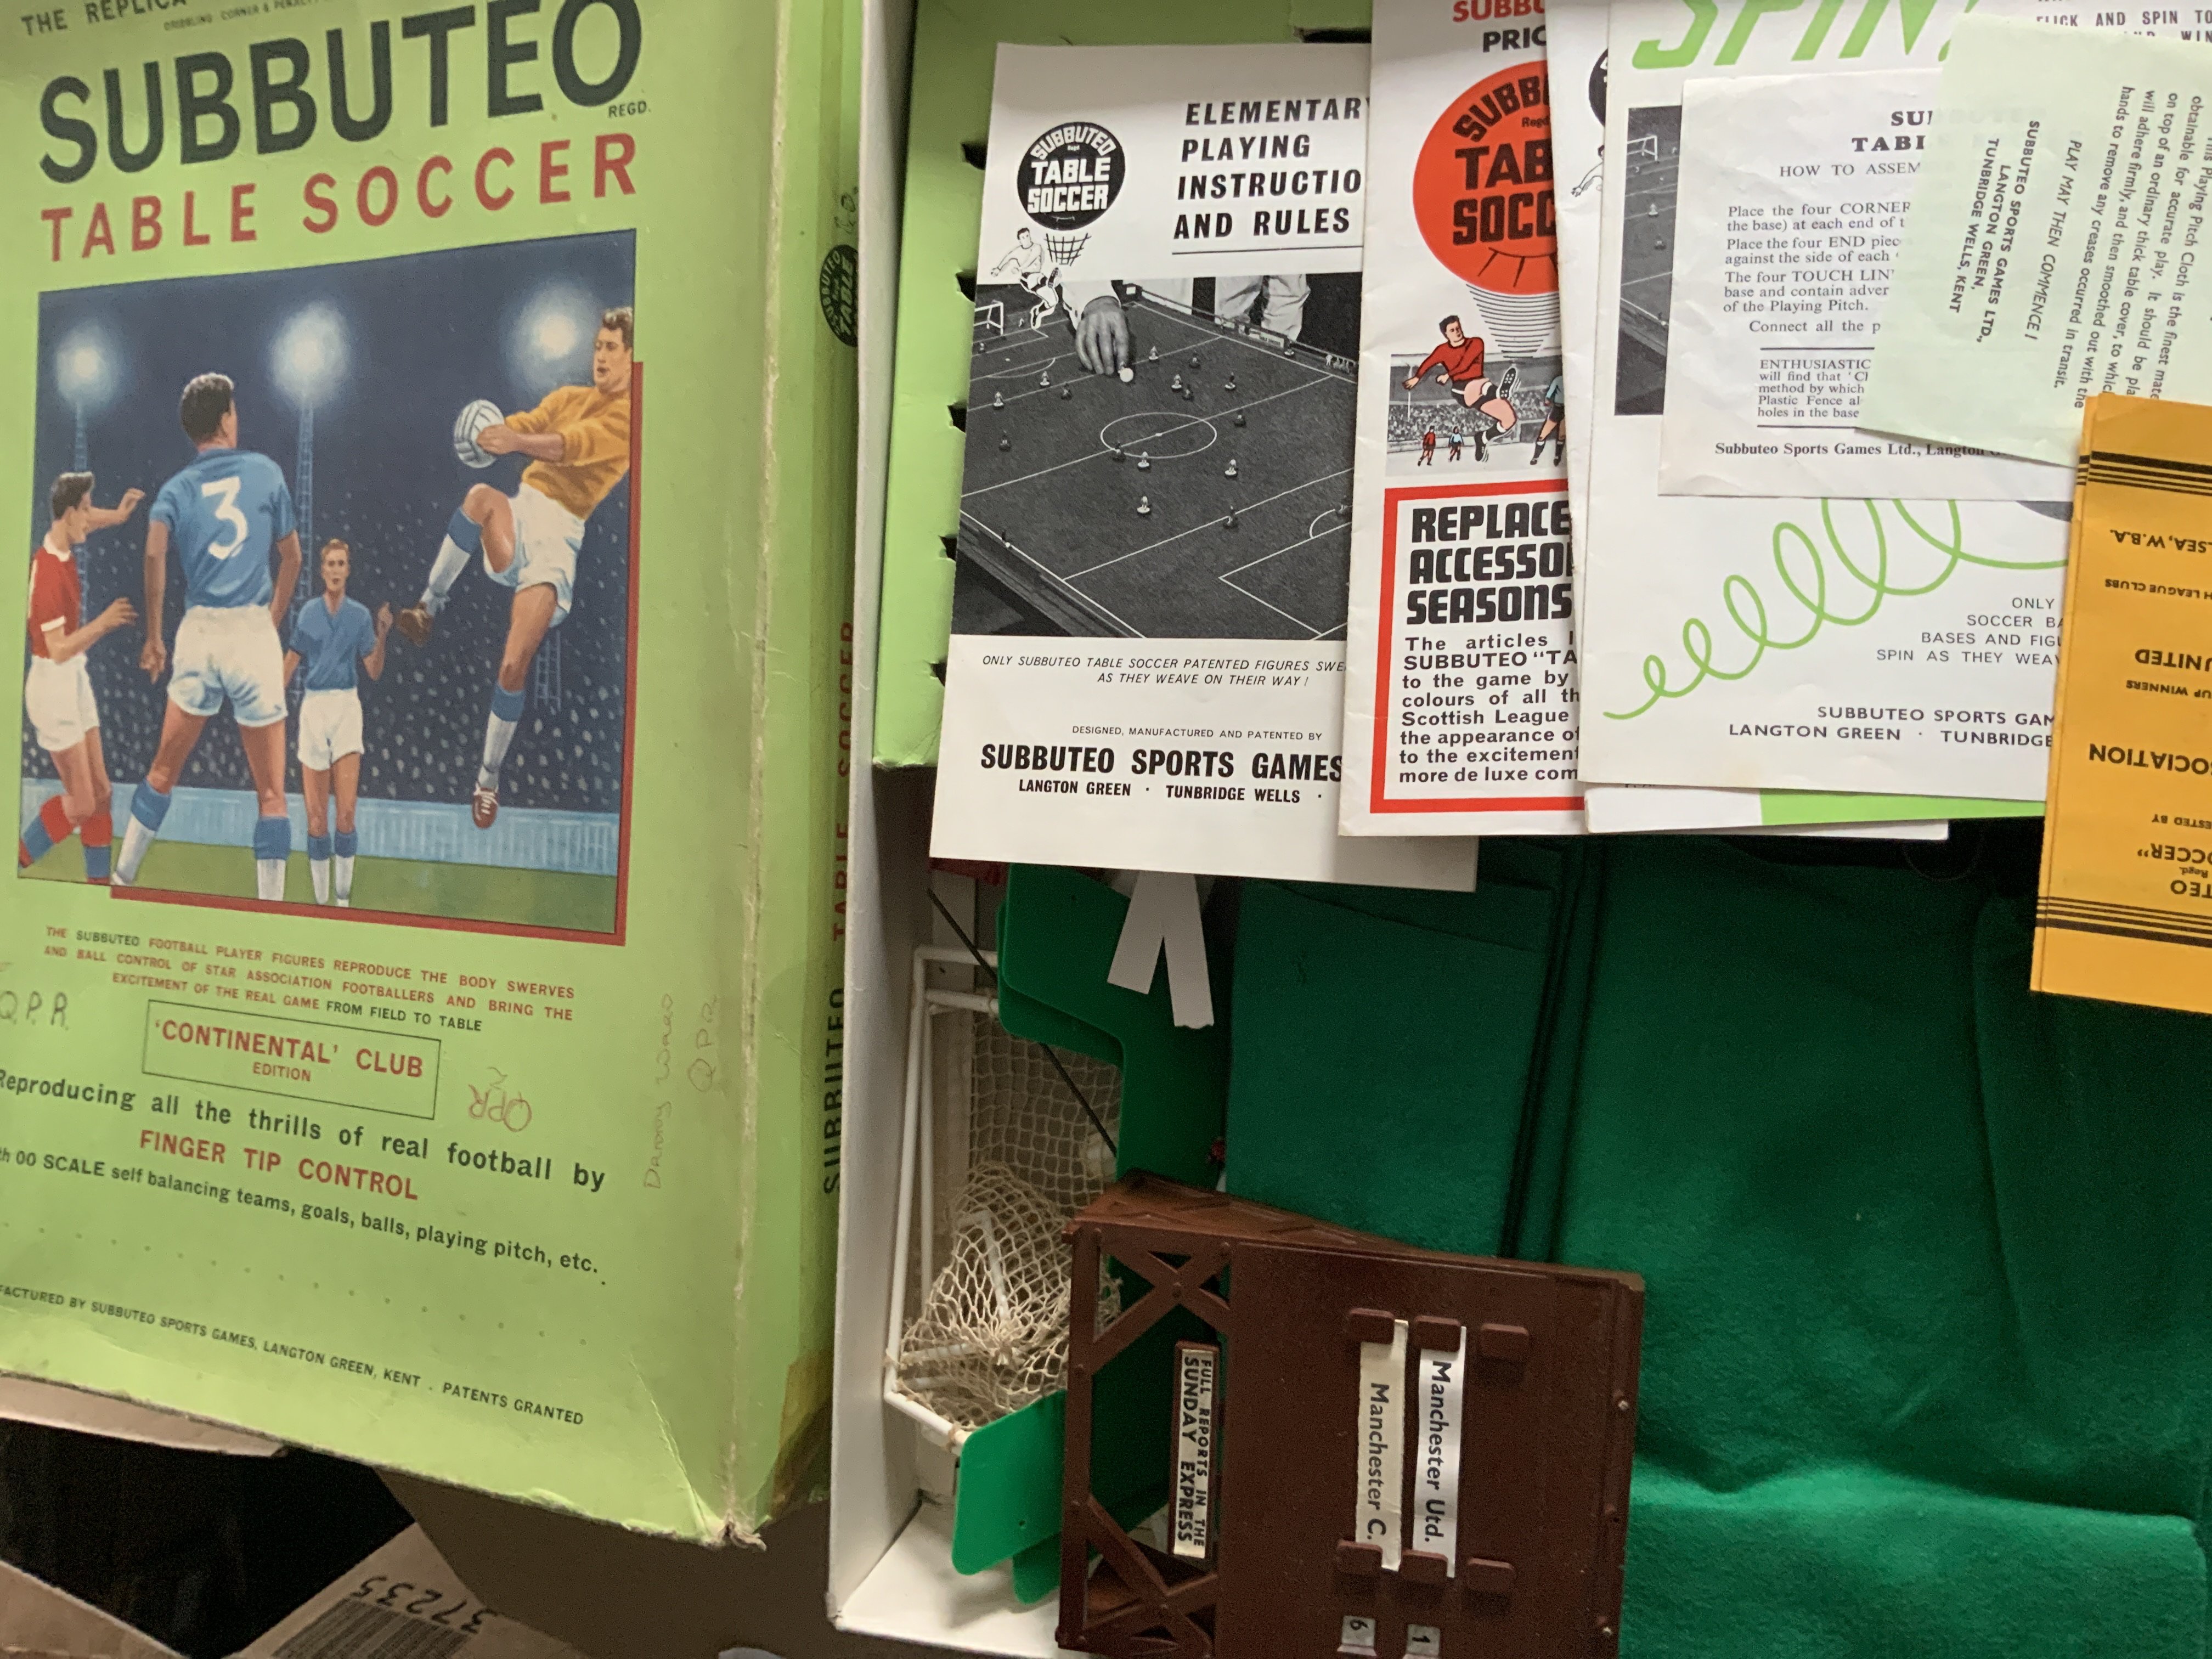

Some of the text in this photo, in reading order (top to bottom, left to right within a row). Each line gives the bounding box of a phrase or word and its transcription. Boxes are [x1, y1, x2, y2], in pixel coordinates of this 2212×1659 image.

[21, 8, 67, 36] THE
[2096, 11, 2177, 26] AND SPIN
[39, 0, 651, 184] SUBBUTEO REGD.
[1452, 75, 1550, 143] SUBB
[1182, 134, 1309, 162] PLAYING
[1031, 157, 1111, 185] TABLE
[1781, 165, 1854, 177] HOW TO
[41, 133, 636, 262] TABLE SOCCER
[1028, 184, 1109, 213] SOCCER
[1729, 204, 1831, 217] Place the four
[1174, 208, 1349, 239] AND RULES
[1950, 139, 1999, 313] TUNBRIDGE WELLS, KENT
[1988, 121, 2040, 304] SUBBUTEO SPORTS GAMES
[1971, 165, 2011, 290] LANGTON GREEN,
[2027, 140, 2082, 331] PLAY MAY THEN COMMENCE
[1770, 300, 1867, 314] Playing Pitch.
[1716, 443, 1921, 457] Subbuteo Sports Games Ltd.,
[201, 476, 248, 560] 3
[2111, 530, 2165, 548] W.B.A.
[1409, 541, 1573, 585] ACCESSO
[2105, 579, 2200, 598] LEAGUE CLUBS
[1407, 583, 1572, 625] SEASONS
[2012, 597, 2054, 609] ONLY
[1967, 615, 2032, 627] SOCCER
[1405, 633, 1547, 651] The articles
[1922, 633, 2021, 645] BASES AND
[983, 656, 1309, 671] ONLY SUBBUTEO TABLE SOCCER PATENTED FIGURES
[1404, 652, 1527, 670] SUBBUTEO
[1098, 673, 1300, 685] AS THEY WEAVE ON THEIR WAY
[1402, 670, 1569, 690] to the game by
[2126, 680, 2188, 696] WINNERS
[1402, 689, 1545, 707] colours of all
[1402, 710, 1569, 726] Scottish League
[1818, 707, 2006, 724] SUBBUTEO SPORTS
[1073, 726, 1124, 735] DESIGNED,
[1129, 727, 1214, 737] MANUFACTURED
[1248, 731, 1303, 740] PATENTED
[1730, 724, 1900, 740] LANGTON GREEN
[981, 744, 1342, 783] SUBBUTEO SPORTS GAMES
[1019, 780, 1300, 803] LANGTON GREEN TUNBRIDGE WELLS
[47, 927, 574, 998] THE SUBBUTEO FOOTBALL PLAYER FIGURES REPRODUCE THE BODY SWERVES
[253, 1062, 311, 1082] EDITION
[356, 1048, 422, 1077] CLUB
[151, 1095, 178, 1115] all
[196, 1101, 230, 1124] the
[249, 1109, 320, 1139] thrills
[339, 1126, 364, 1146] of
[382, 1136, 427, 1159] real
[448, 1142, 551, 1180] football
[574, 1163, 605, 1192] by
[140, 1130, 417, 1200] FINGER TIP CONTROL
[43, 1154, 597, 1273] SCALE self balancing teams, goals, balls, playing pitch, etc.
[92, 1302, 583, 1425] SUBBUTEO SPORTS GAMES, LANGTON GREEN, KENT PATENTS GRANTED
[1177, 1356, 1199, 1543] SUNDAY EXPRESS
[1193, 1359, 1212, 1547] FULL REPORTS IN THE
[1365, 1381, 1390, 1541] Manchester C.
[1424, 1361, 1453, 1543] Manchester Utd.
